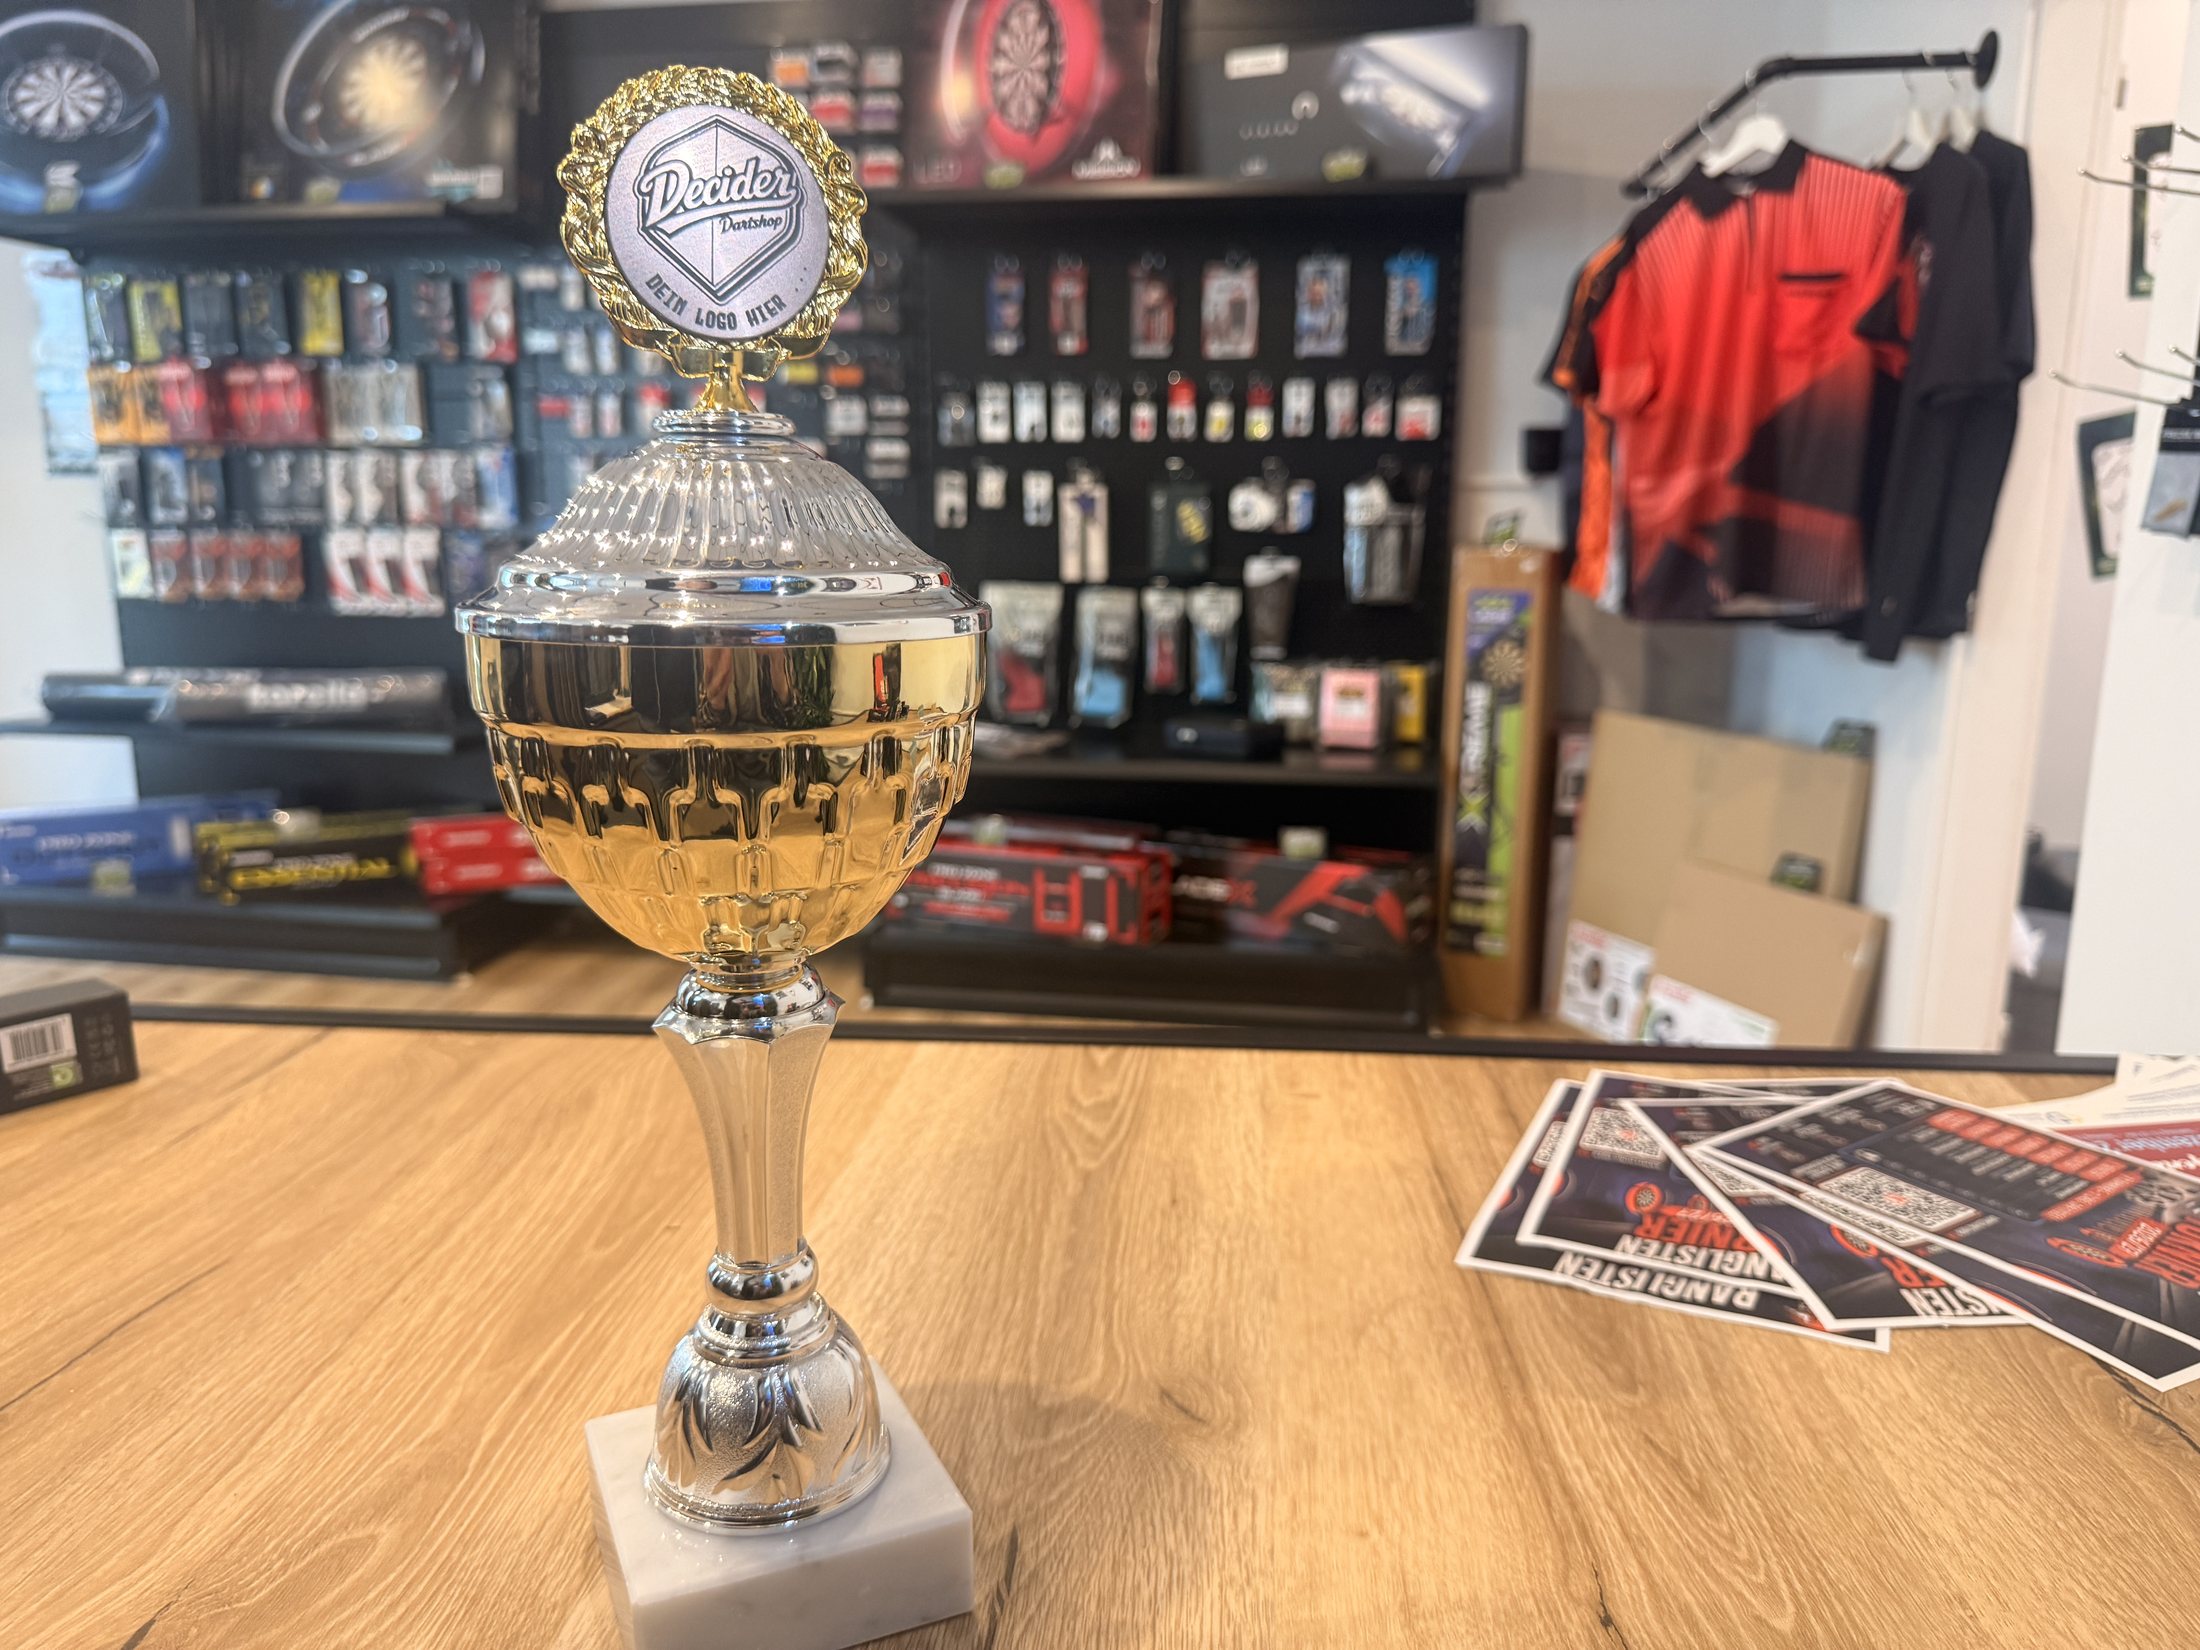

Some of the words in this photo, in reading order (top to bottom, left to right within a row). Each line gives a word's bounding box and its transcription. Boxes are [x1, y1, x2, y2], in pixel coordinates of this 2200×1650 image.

[638, 156, 800, 229] Decider
[719, 215, 784, 235] Dartshop
[645, 273, 687, 316] DEIN
[694, 308, 738, 332] LOGO
[747, 294, 788, 328] HIER
